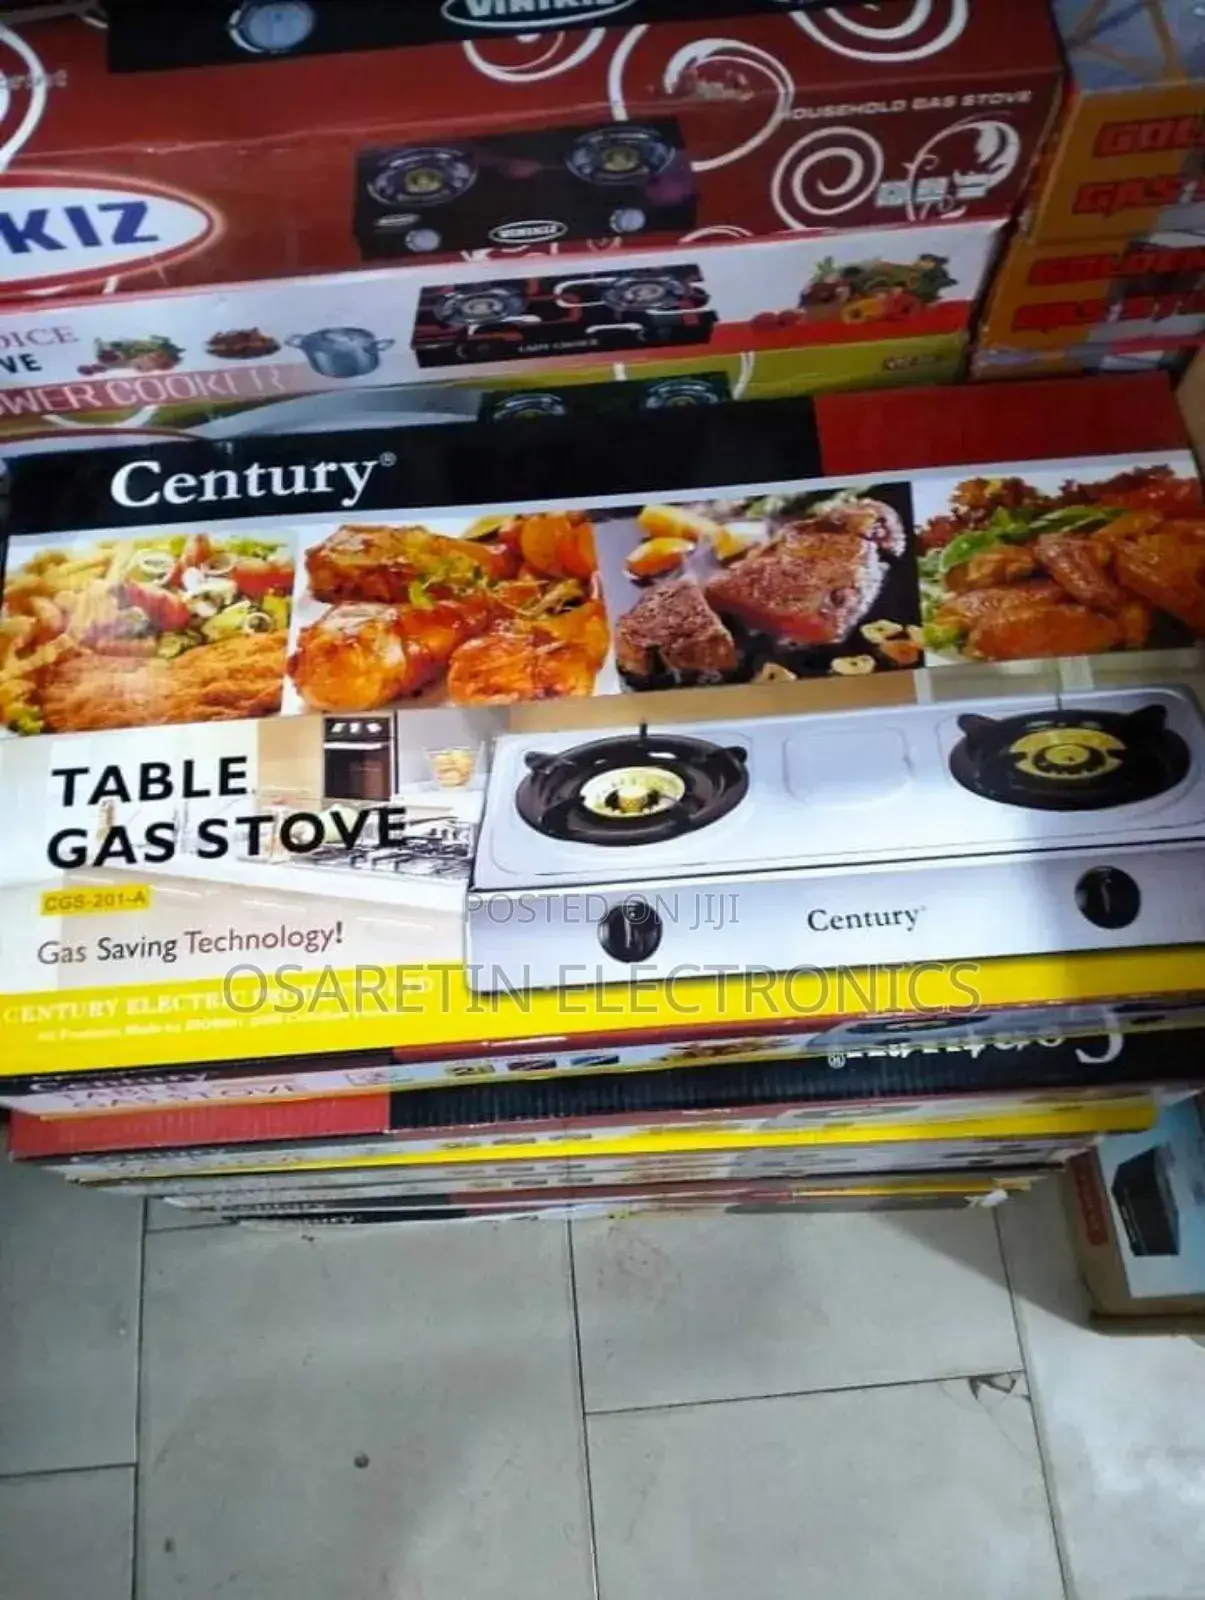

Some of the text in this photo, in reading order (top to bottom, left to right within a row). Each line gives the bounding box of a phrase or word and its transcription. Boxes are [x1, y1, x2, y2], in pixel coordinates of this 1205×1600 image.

[465, 0, 618, 17] VINIK
[960, 89, 1032, 107] STOVE
[110, 459, 378, 508] Century
[51, 755, 248, 807] TABLE
[47, 806, 407, 869] GAS STOVE
[43, 889, 147, 912] CGS-201-A
[807, 907, 919, 932] Century
[38, 920, 344, 965] Gas Saving Technology!
[3, 998, 120, 1025] CENTURY
